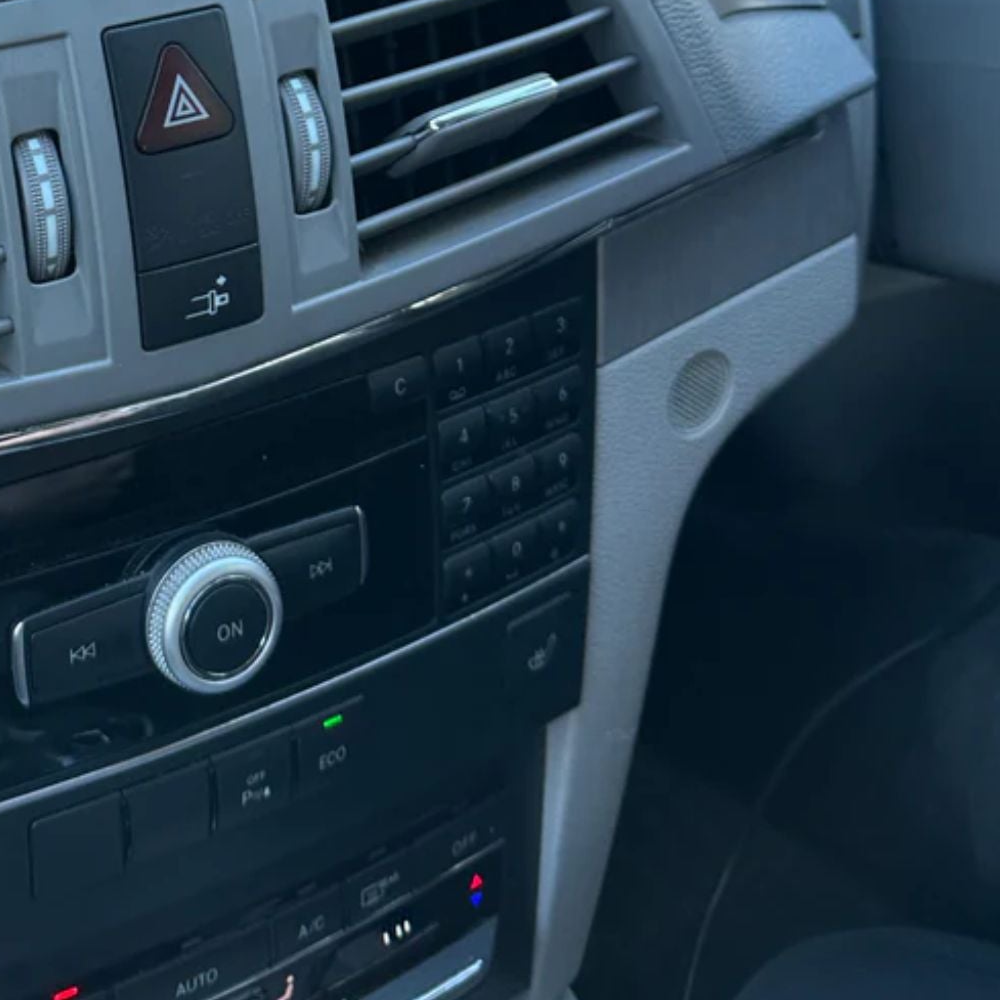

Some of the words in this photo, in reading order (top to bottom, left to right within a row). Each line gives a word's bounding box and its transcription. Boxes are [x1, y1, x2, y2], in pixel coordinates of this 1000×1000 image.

[505, 336, 515, 356] 2
[394, 377, 408, 397] C
[217, 619, 245, 642] ON
[318, 744, 348, 771] ECO
[174, 966, 219, 999] AUTO
